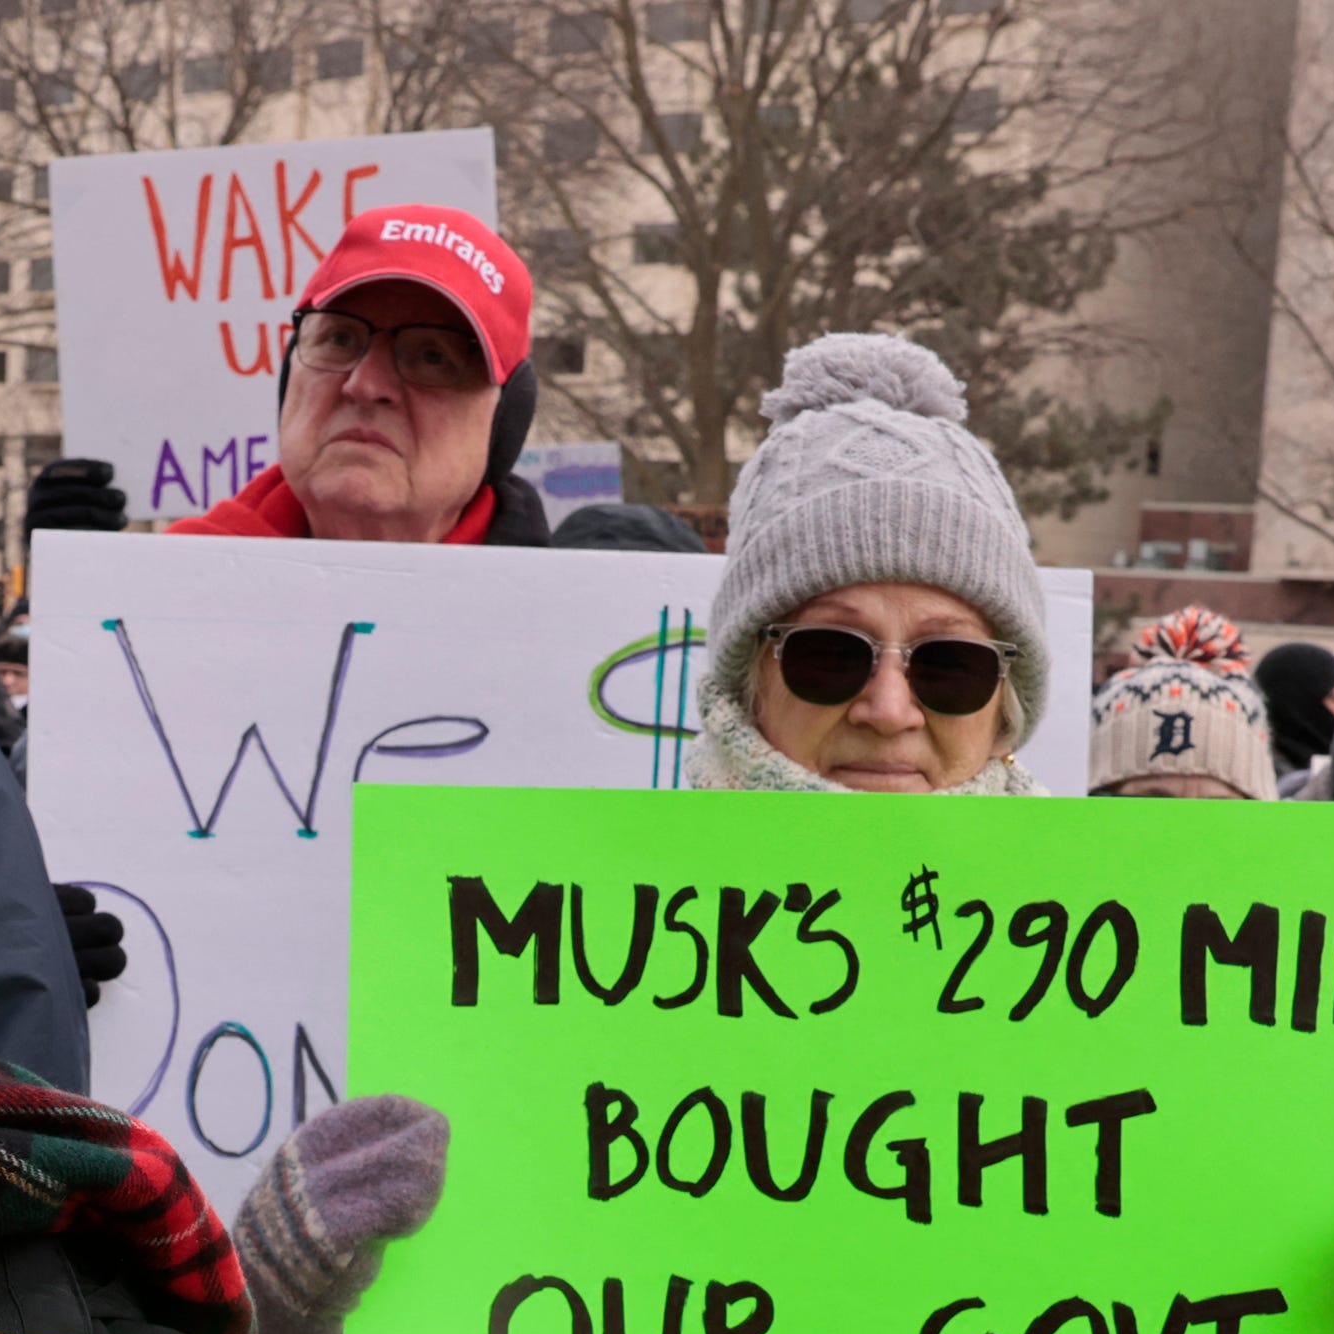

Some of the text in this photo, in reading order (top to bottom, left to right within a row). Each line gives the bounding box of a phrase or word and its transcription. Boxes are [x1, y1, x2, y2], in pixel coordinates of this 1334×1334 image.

[370, 218, 506, 296] Emirates
[1150, 709, 1196, 762] D
[445, 874, 861, 1021] MUSK'S
[900, 863, 1141, 1023] $290
[583, 1080, 1158, 1226] BOUGHT
